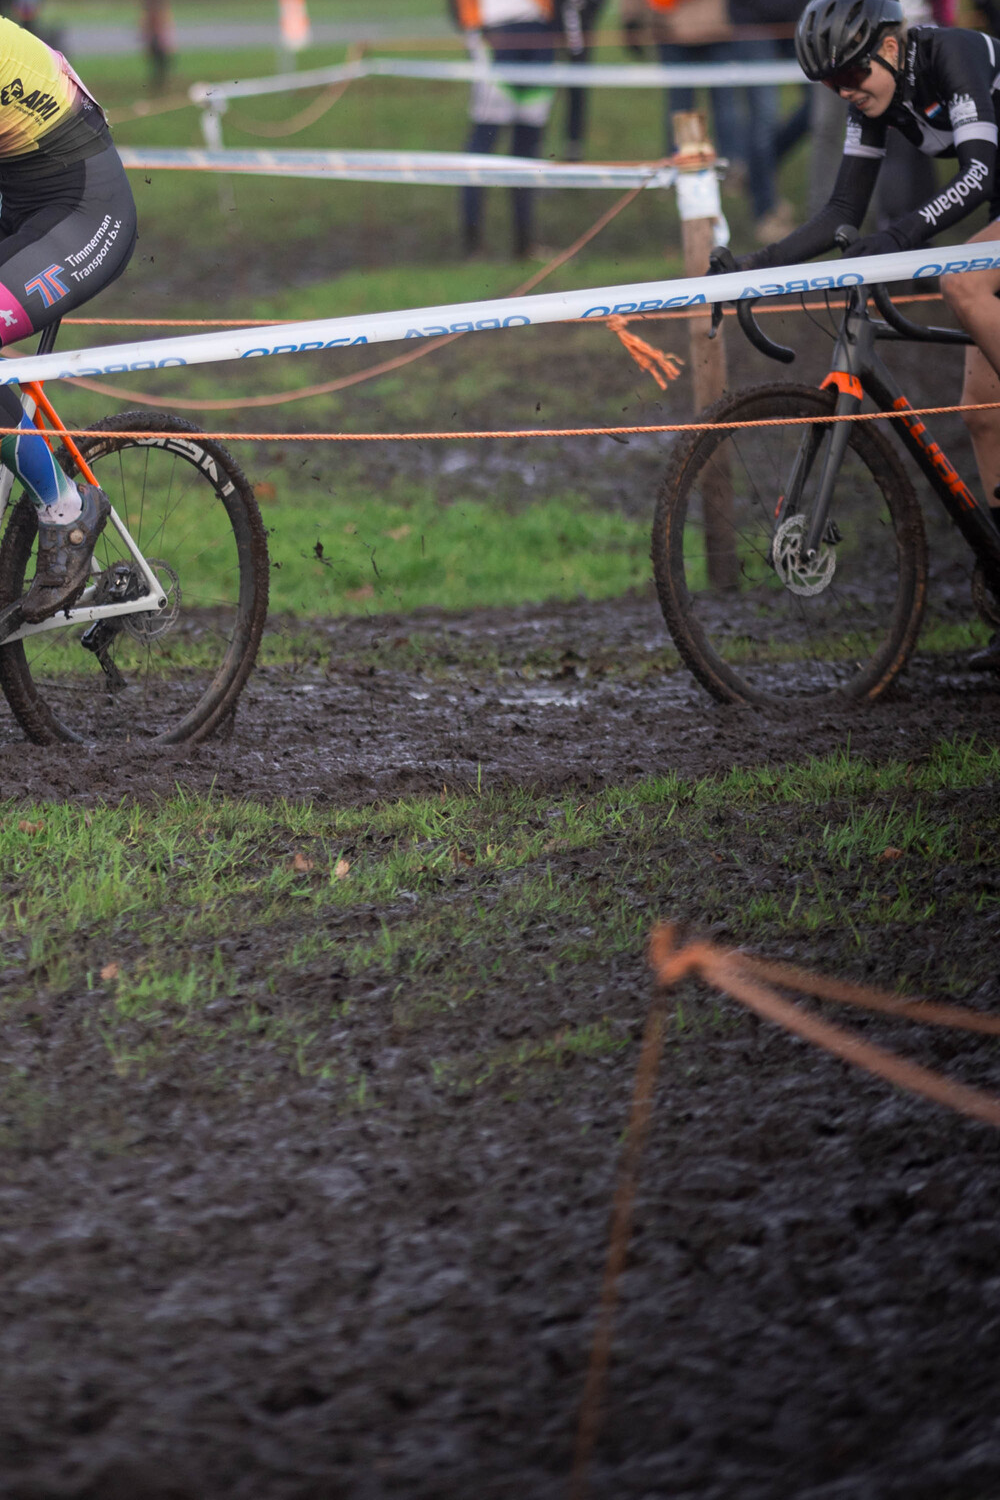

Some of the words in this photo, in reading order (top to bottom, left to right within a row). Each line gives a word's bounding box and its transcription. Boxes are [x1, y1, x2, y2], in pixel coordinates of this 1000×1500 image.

[919, 158, 989, 226] Rabobank
[64, 214, 112, 267] Timmerman
[70, 239, 113, 282] Transport
[108, 219, 122, 240] b.v.
